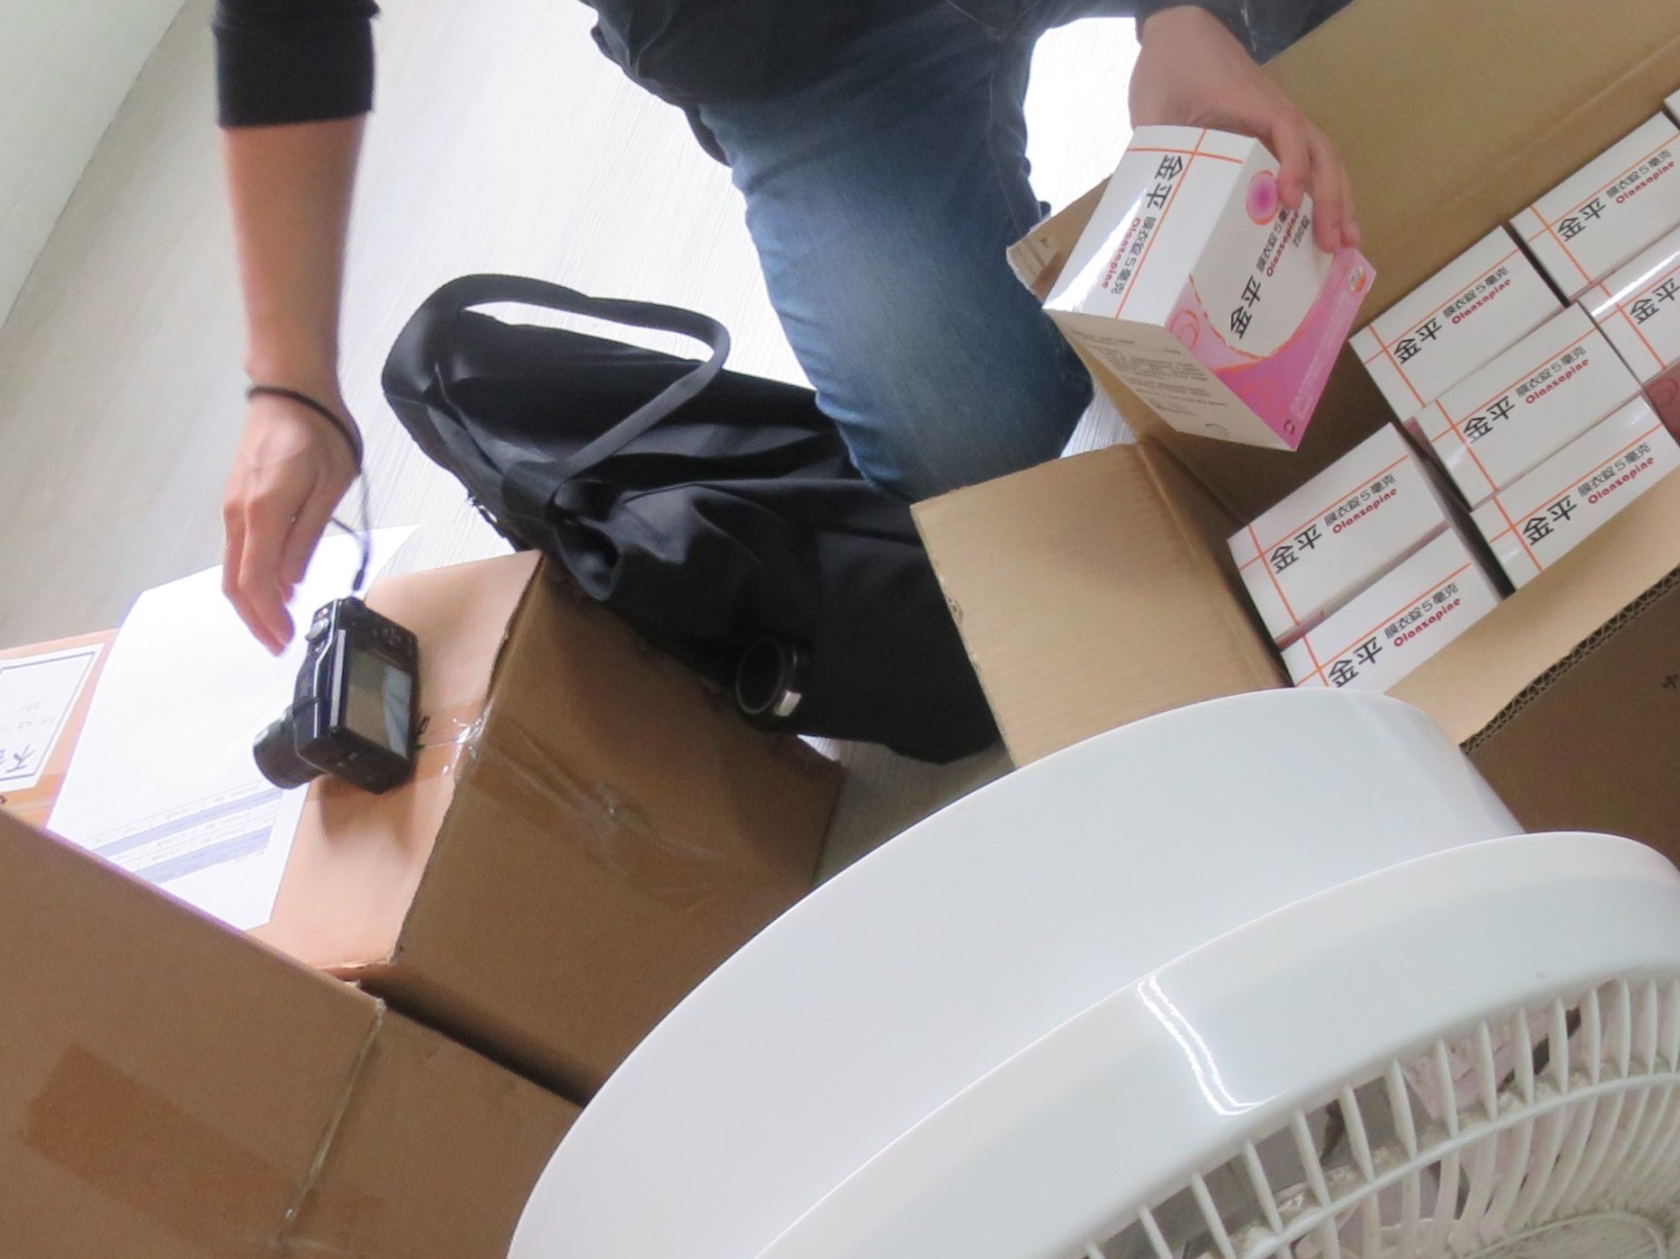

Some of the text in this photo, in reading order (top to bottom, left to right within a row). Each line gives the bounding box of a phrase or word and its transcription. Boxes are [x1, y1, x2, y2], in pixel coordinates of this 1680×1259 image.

[1145, 154, 1183, 210] 金平
[1616, 160, 1675, 204] Olanzapine
[1557, 197, 1606, 242] 金平
[1101, 217, 1141, 289] Olanzapine
[1230, 275, 1261, 340] 金平
[1451, 277, 1511, 325] Olanzapine
[1629, 278, 1680, 325] 金平
[1393, 317, 1442, 364] 金平
[1525, 358, 1589, 405] Olanzapine
[1462, 396, 1515, 444] 金平
[1588, 456, 1654, 504] Olanzapine
[1332, 487, 1397, 534] Olanzapine
[1523, 495, 1578, 545] 金平
[1269, 524, 1322, 574] 金平
[1393, 596, 1461, 647] Olanzapine
[1328, 636, 1383, 688] 金平
